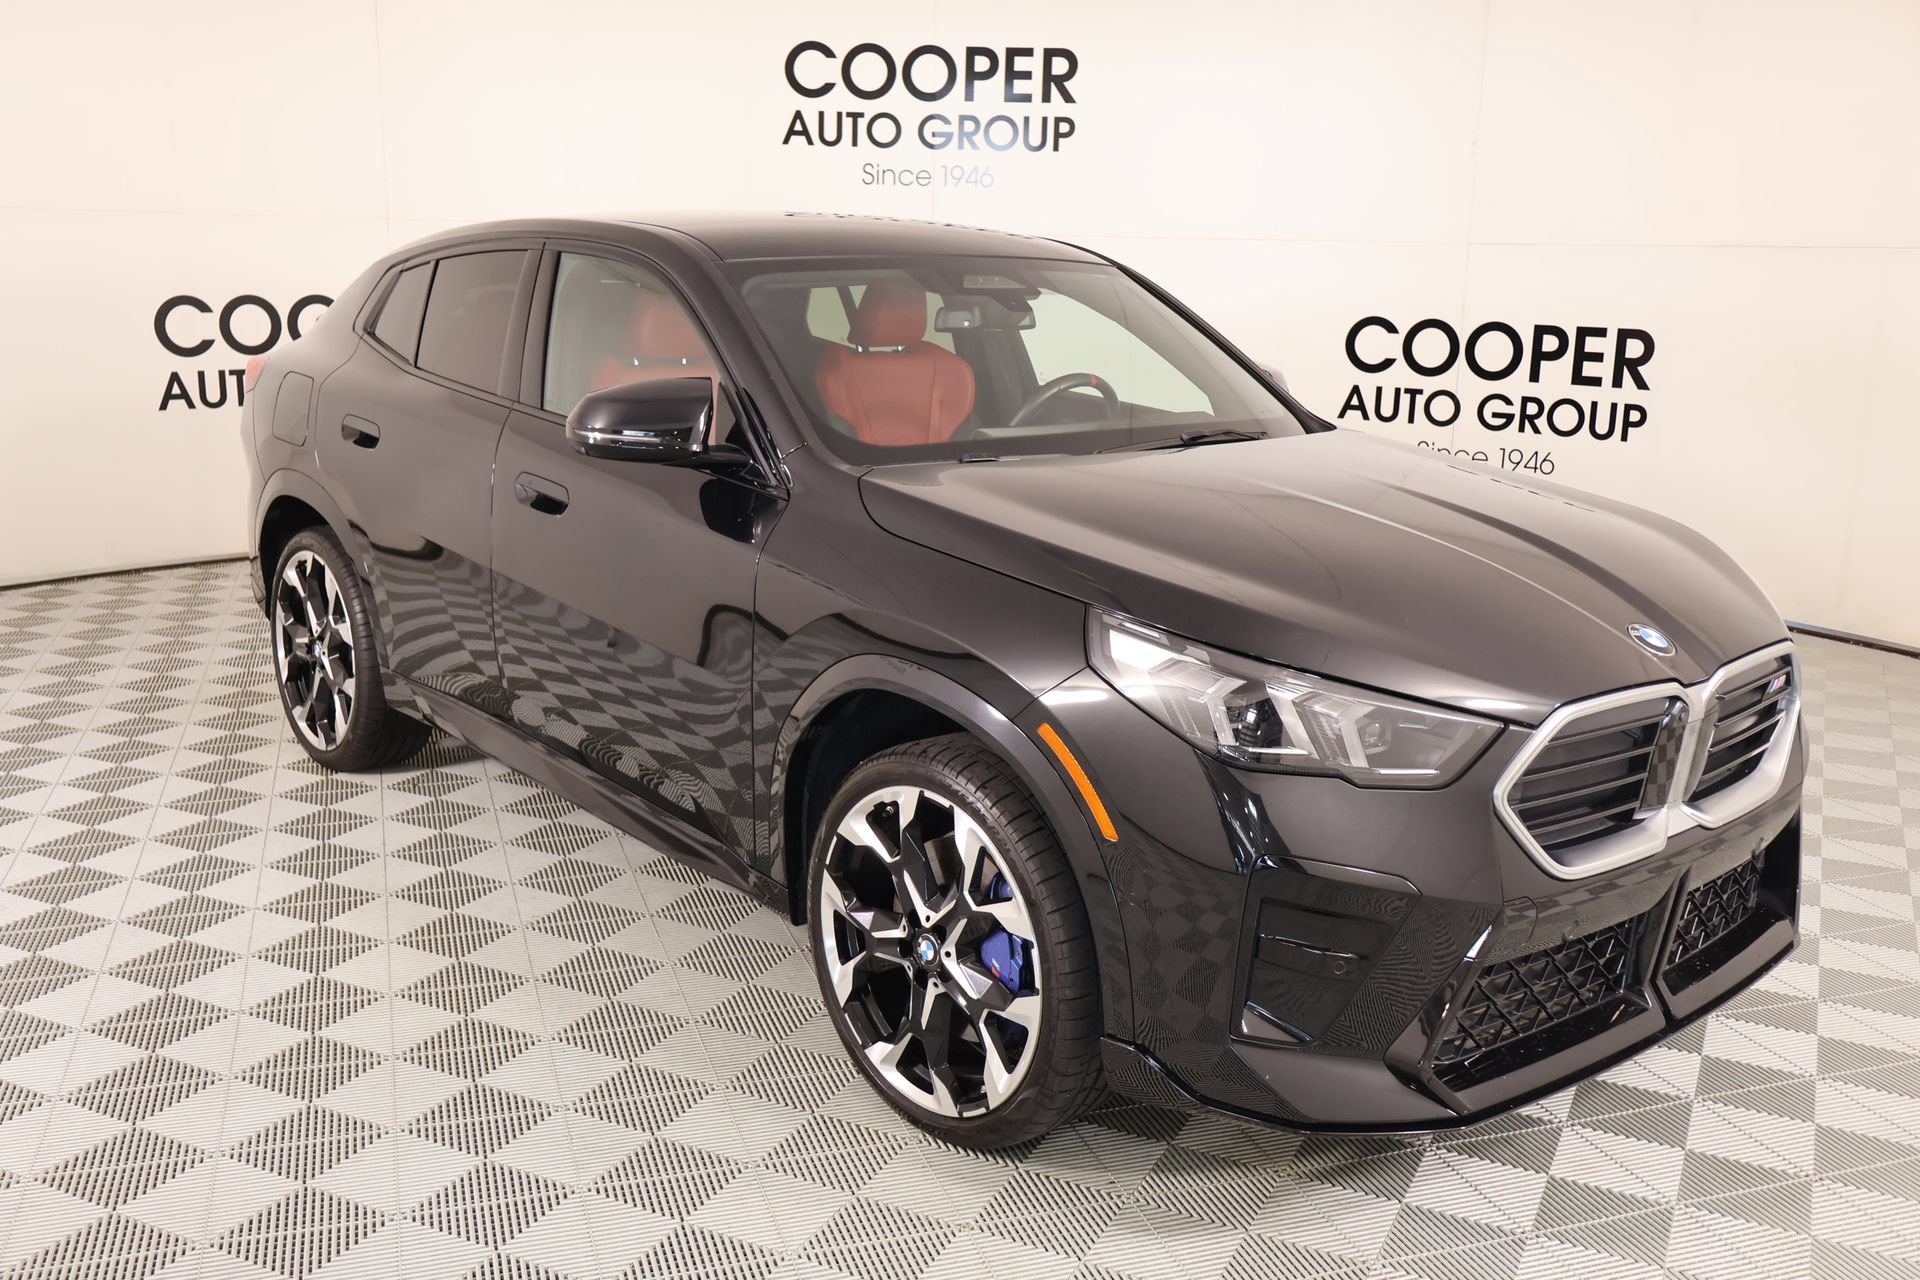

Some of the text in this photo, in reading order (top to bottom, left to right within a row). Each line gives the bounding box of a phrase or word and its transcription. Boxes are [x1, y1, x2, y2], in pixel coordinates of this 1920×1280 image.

[784, 40, 1079, 104] COOPER
[781, 109, 1076, 153] AUTO GROUP
[862, 163, 994, 188] Since 1946
[1345, 316, 1656, 391] COOPER
[1337, 384, 1648, 443] AUTO GROUP
[1499, 447, 1556, 476] 1946
